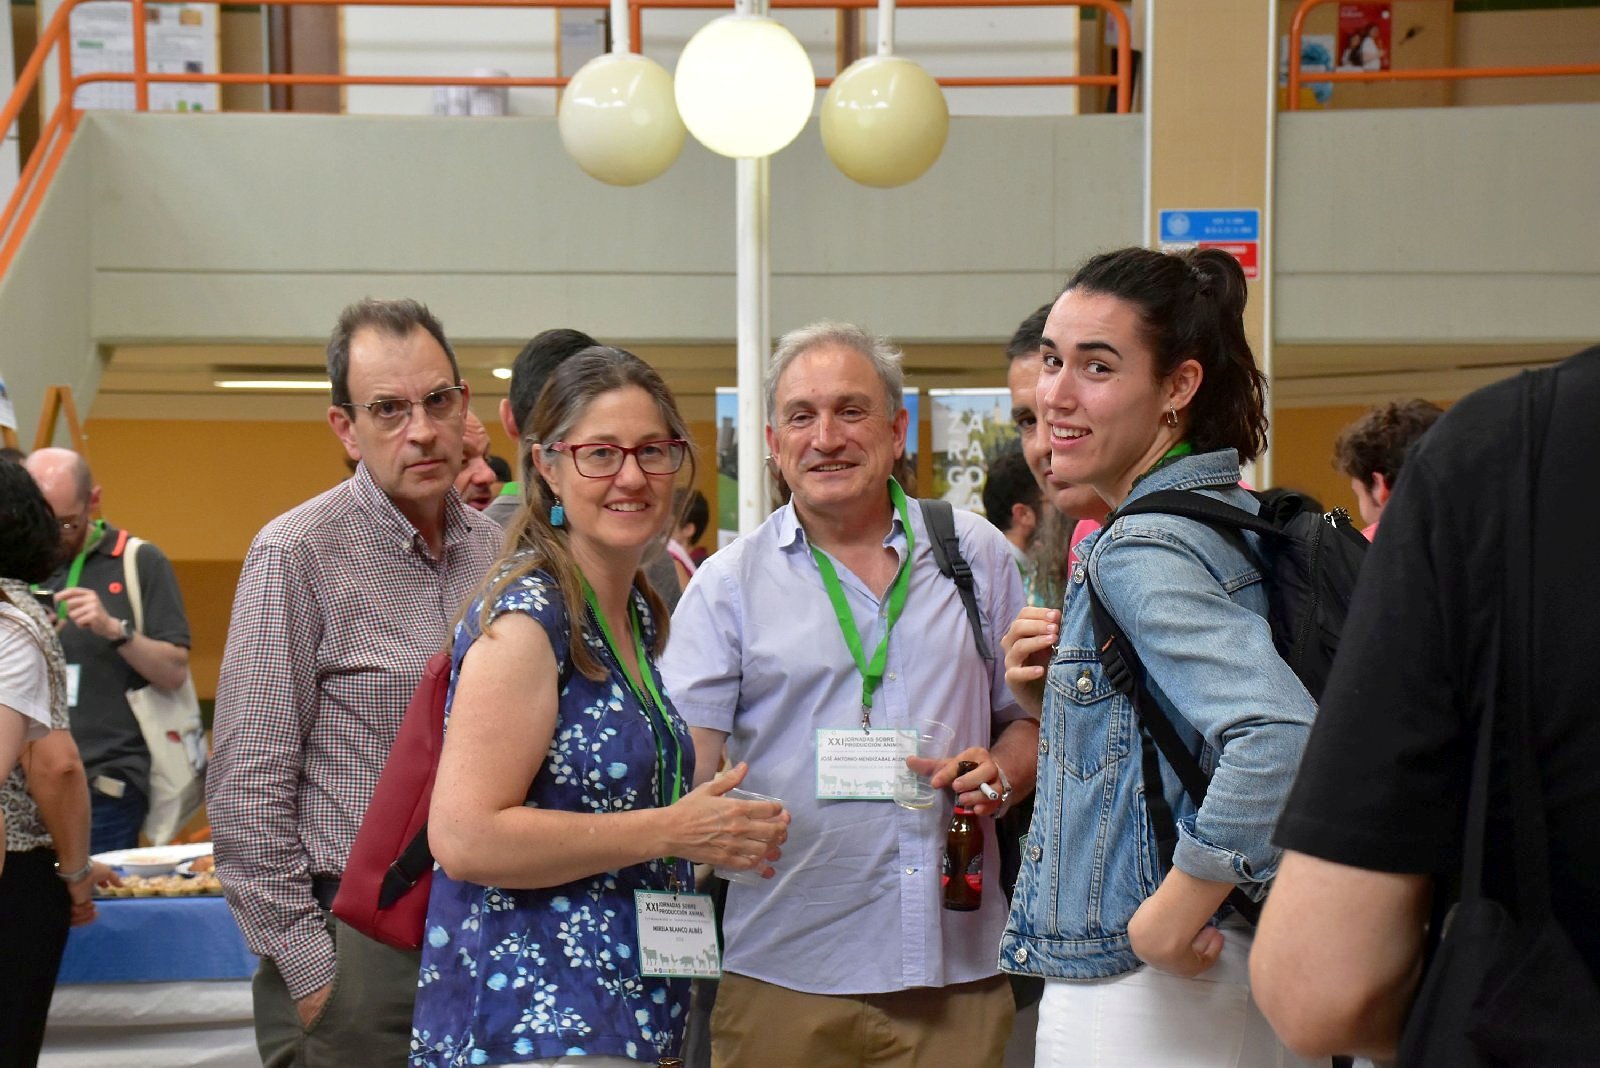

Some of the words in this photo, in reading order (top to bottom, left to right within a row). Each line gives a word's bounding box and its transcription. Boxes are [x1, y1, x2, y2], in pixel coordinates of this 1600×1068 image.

[947, 441, 985, 461] RA
[947, 465, 985, 486] GO
[827, 737, 844, 746] XXI
[645, 902, 659, 912] XXI
[659, 901, 681, 909] JORNADAS
[659, 908, 687, 916] PRODUCCIÓN
[688, 910, 705, 918] ANIMAL
[669, 926, 688, 934] BLANCO
